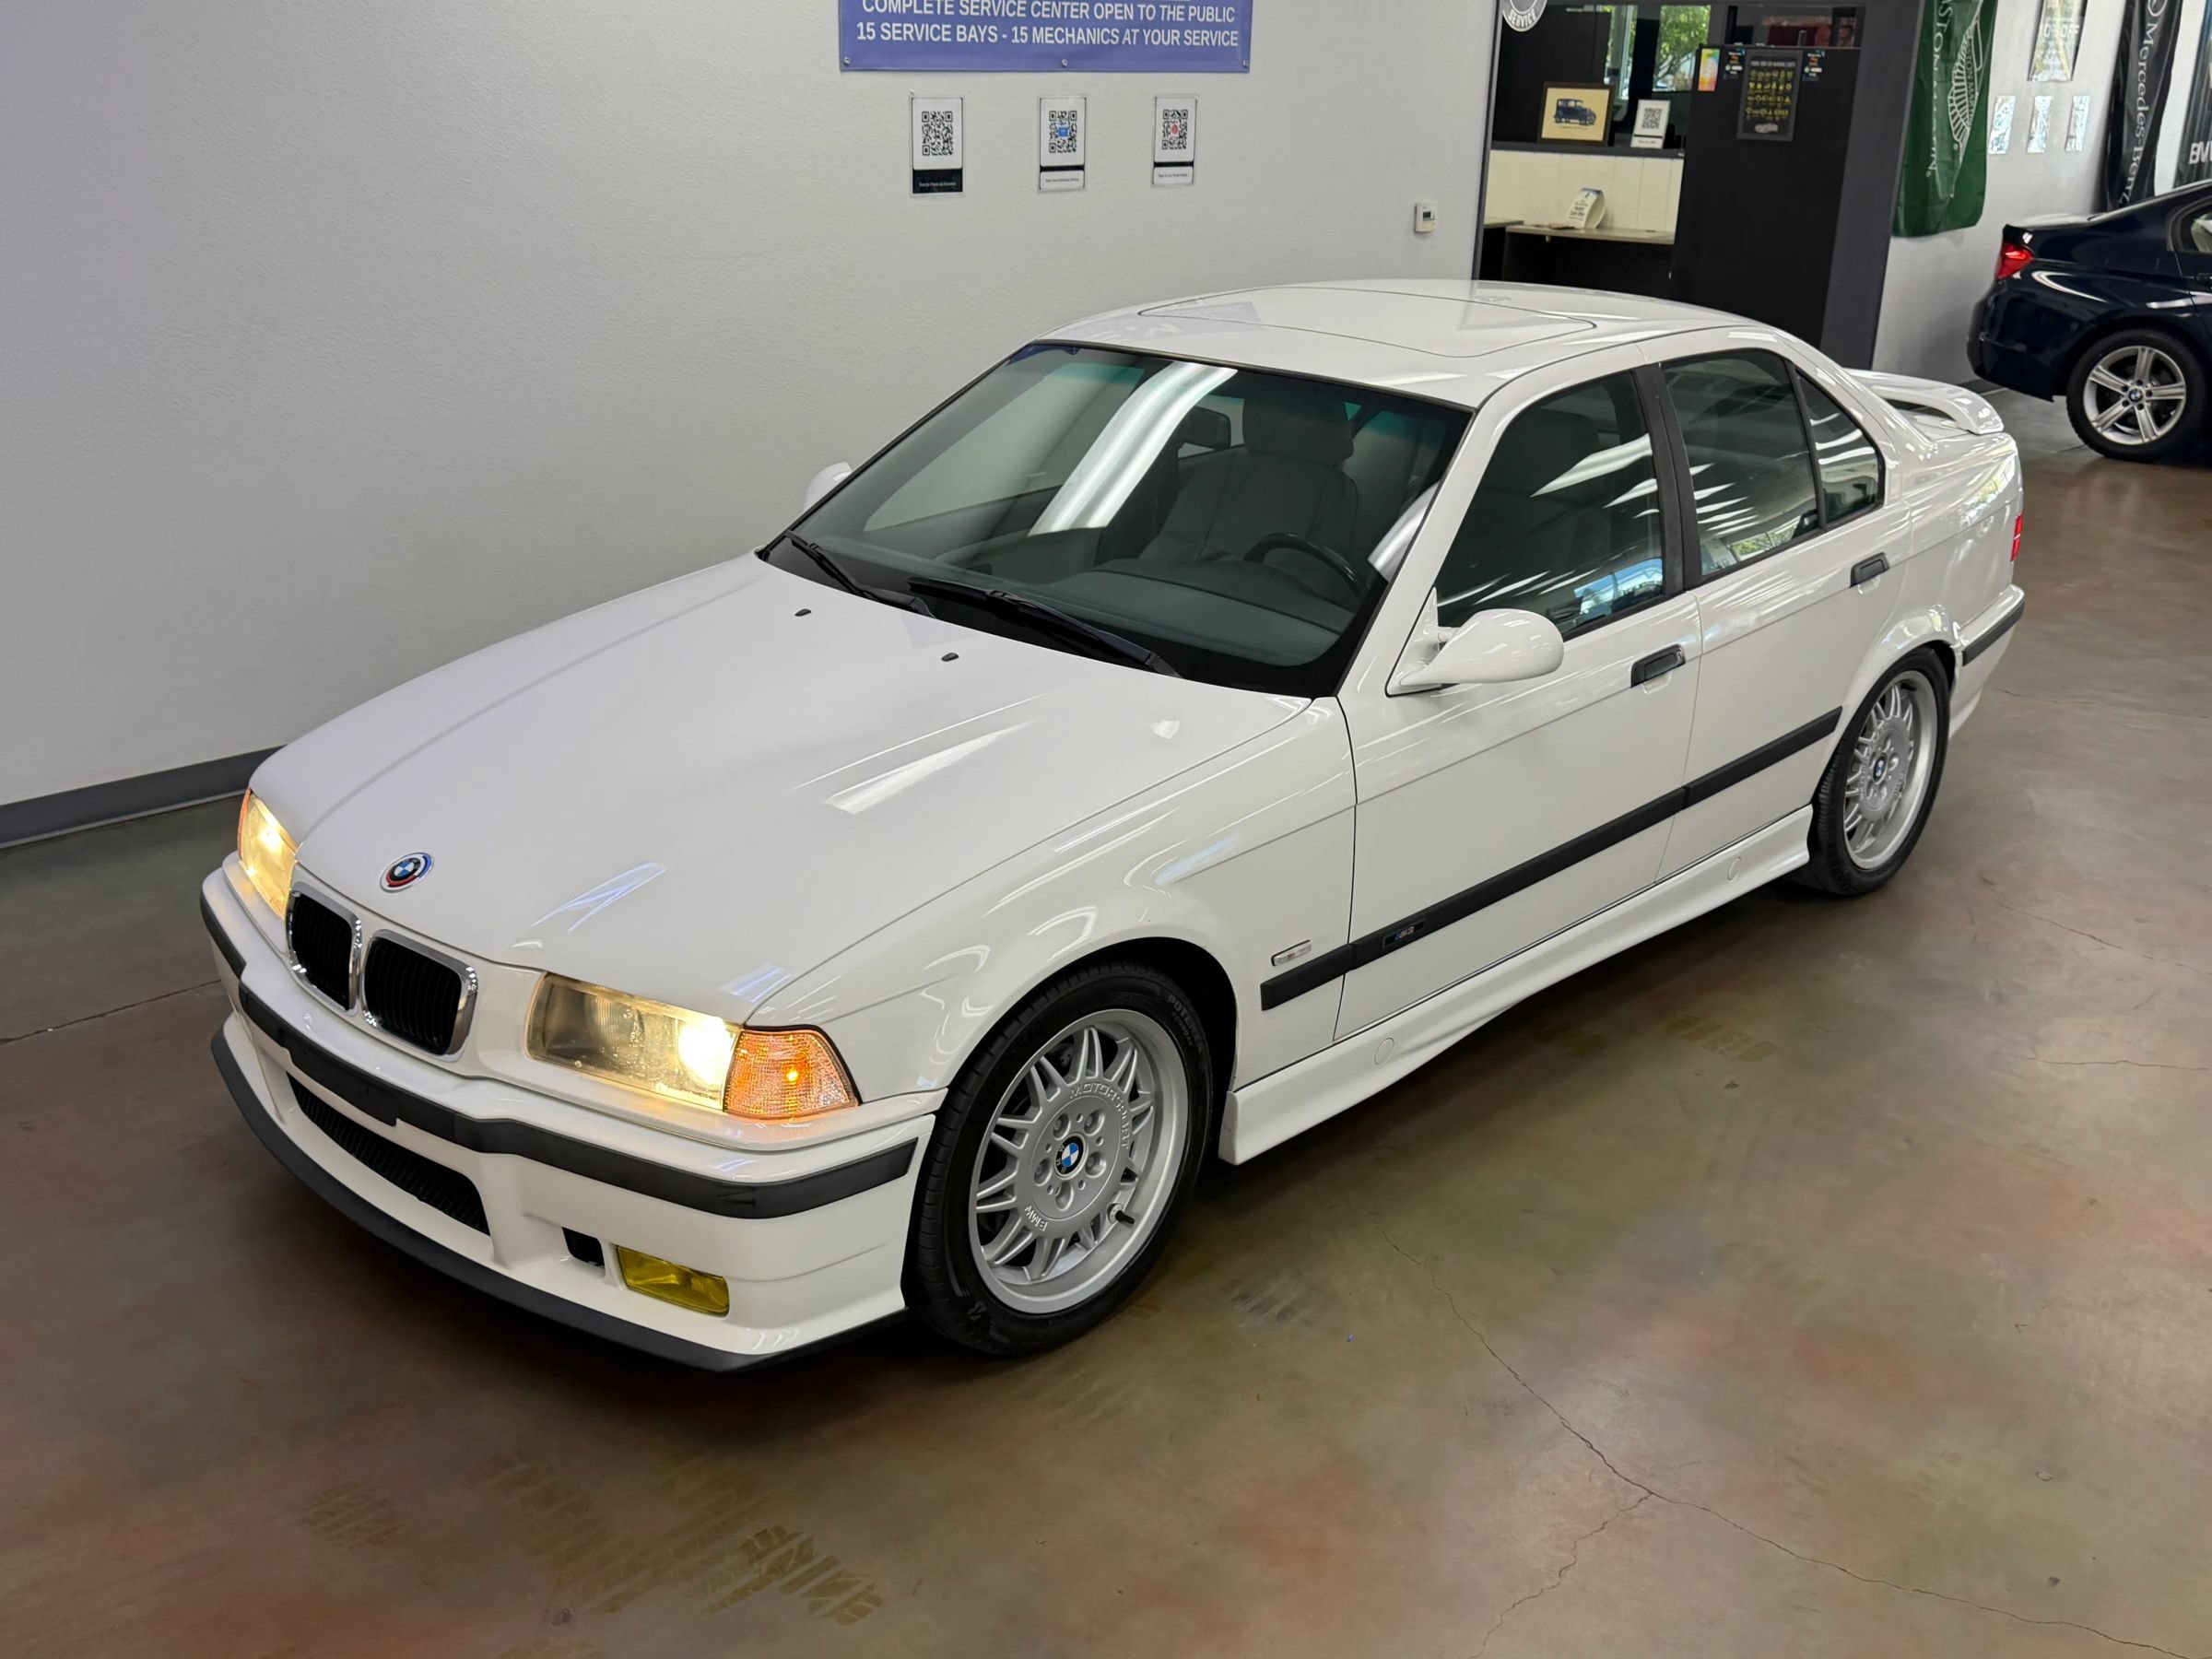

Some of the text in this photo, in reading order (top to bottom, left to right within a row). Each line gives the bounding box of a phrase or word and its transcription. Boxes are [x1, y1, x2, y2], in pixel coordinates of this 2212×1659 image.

[862, 0, 1236, 23] COMPLETE SERVICE CENTER OPEN TO THE PUBLIC
[856, 21, 876, 41] 15
[880, 23, 952, 41] SERVICE
[956, 25, 999, 42] BAYS
[1011, 26, 1029, 43] 15
[1032, 26, 1120, 44] MECHANICS
[1122, 29, 1139, 45] AT
[1143, 29, 1181, 46] YOUR
[1183, 30, 1239, 46] SERVICE
[2120, 22, 2159, 205] Mercedes-Benz
[1024, 1204, 1049, 1233] BMW
